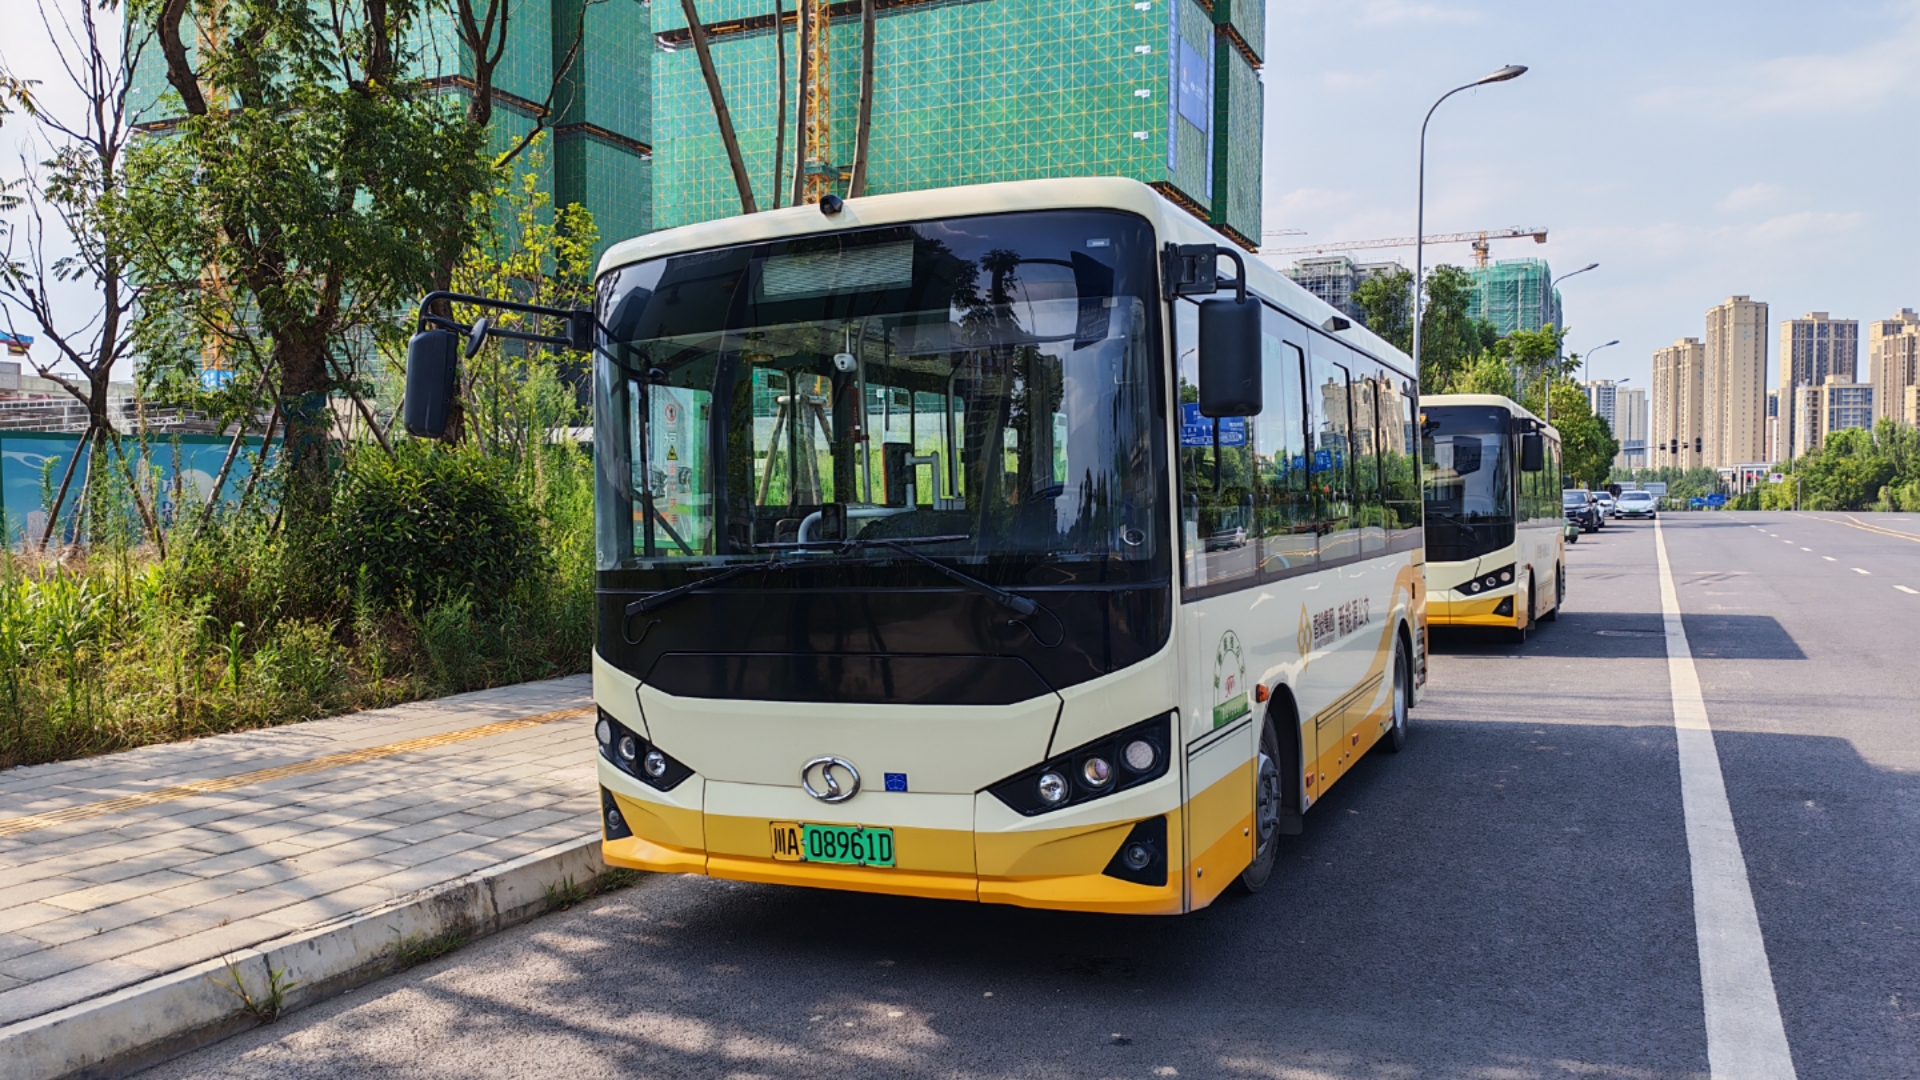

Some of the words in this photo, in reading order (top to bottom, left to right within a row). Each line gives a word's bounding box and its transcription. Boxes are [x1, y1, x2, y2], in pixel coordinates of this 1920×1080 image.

[1338, 595, 1370, 637] 新能源公交
